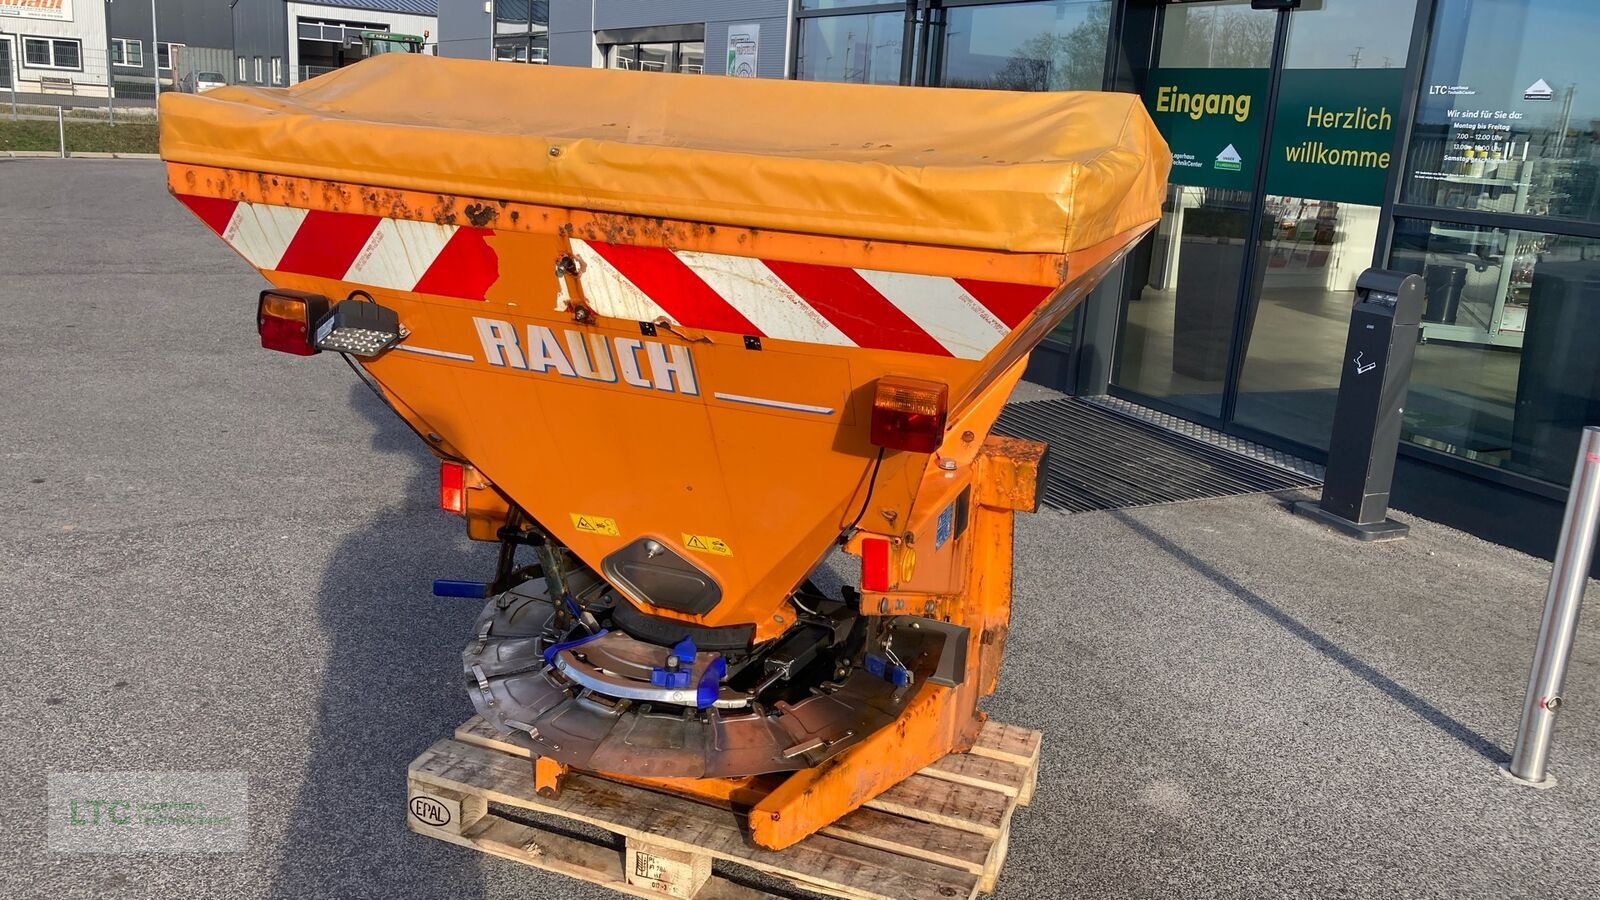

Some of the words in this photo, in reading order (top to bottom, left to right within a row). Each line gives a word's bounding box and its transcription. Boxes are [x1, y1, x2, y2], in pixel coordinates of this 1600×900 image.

[1429, 85, 1448, 95] LTC
[1156, 85, 1251, 122] Eingang
[1306, 106, 1392, 130] Herzlich
[1447, 109, 1461, 118] Wir
[1461, 109, 1479, 118] sind
[1480, 109, 1493, 119] für
[1494, 110, 1508, 119] Sie
[1509, 110, 1524, 119] da:
[1453, 122, 1477, 131] Montag
[1477, 122, 1487, 130] bis
[1487, 123, 1511, 132] Freitag
[1172, 160, 1203, 168] echnikCenter
[472, 316, 699, 396] RAUCH
[416, 800, 445, 823] EPAL
